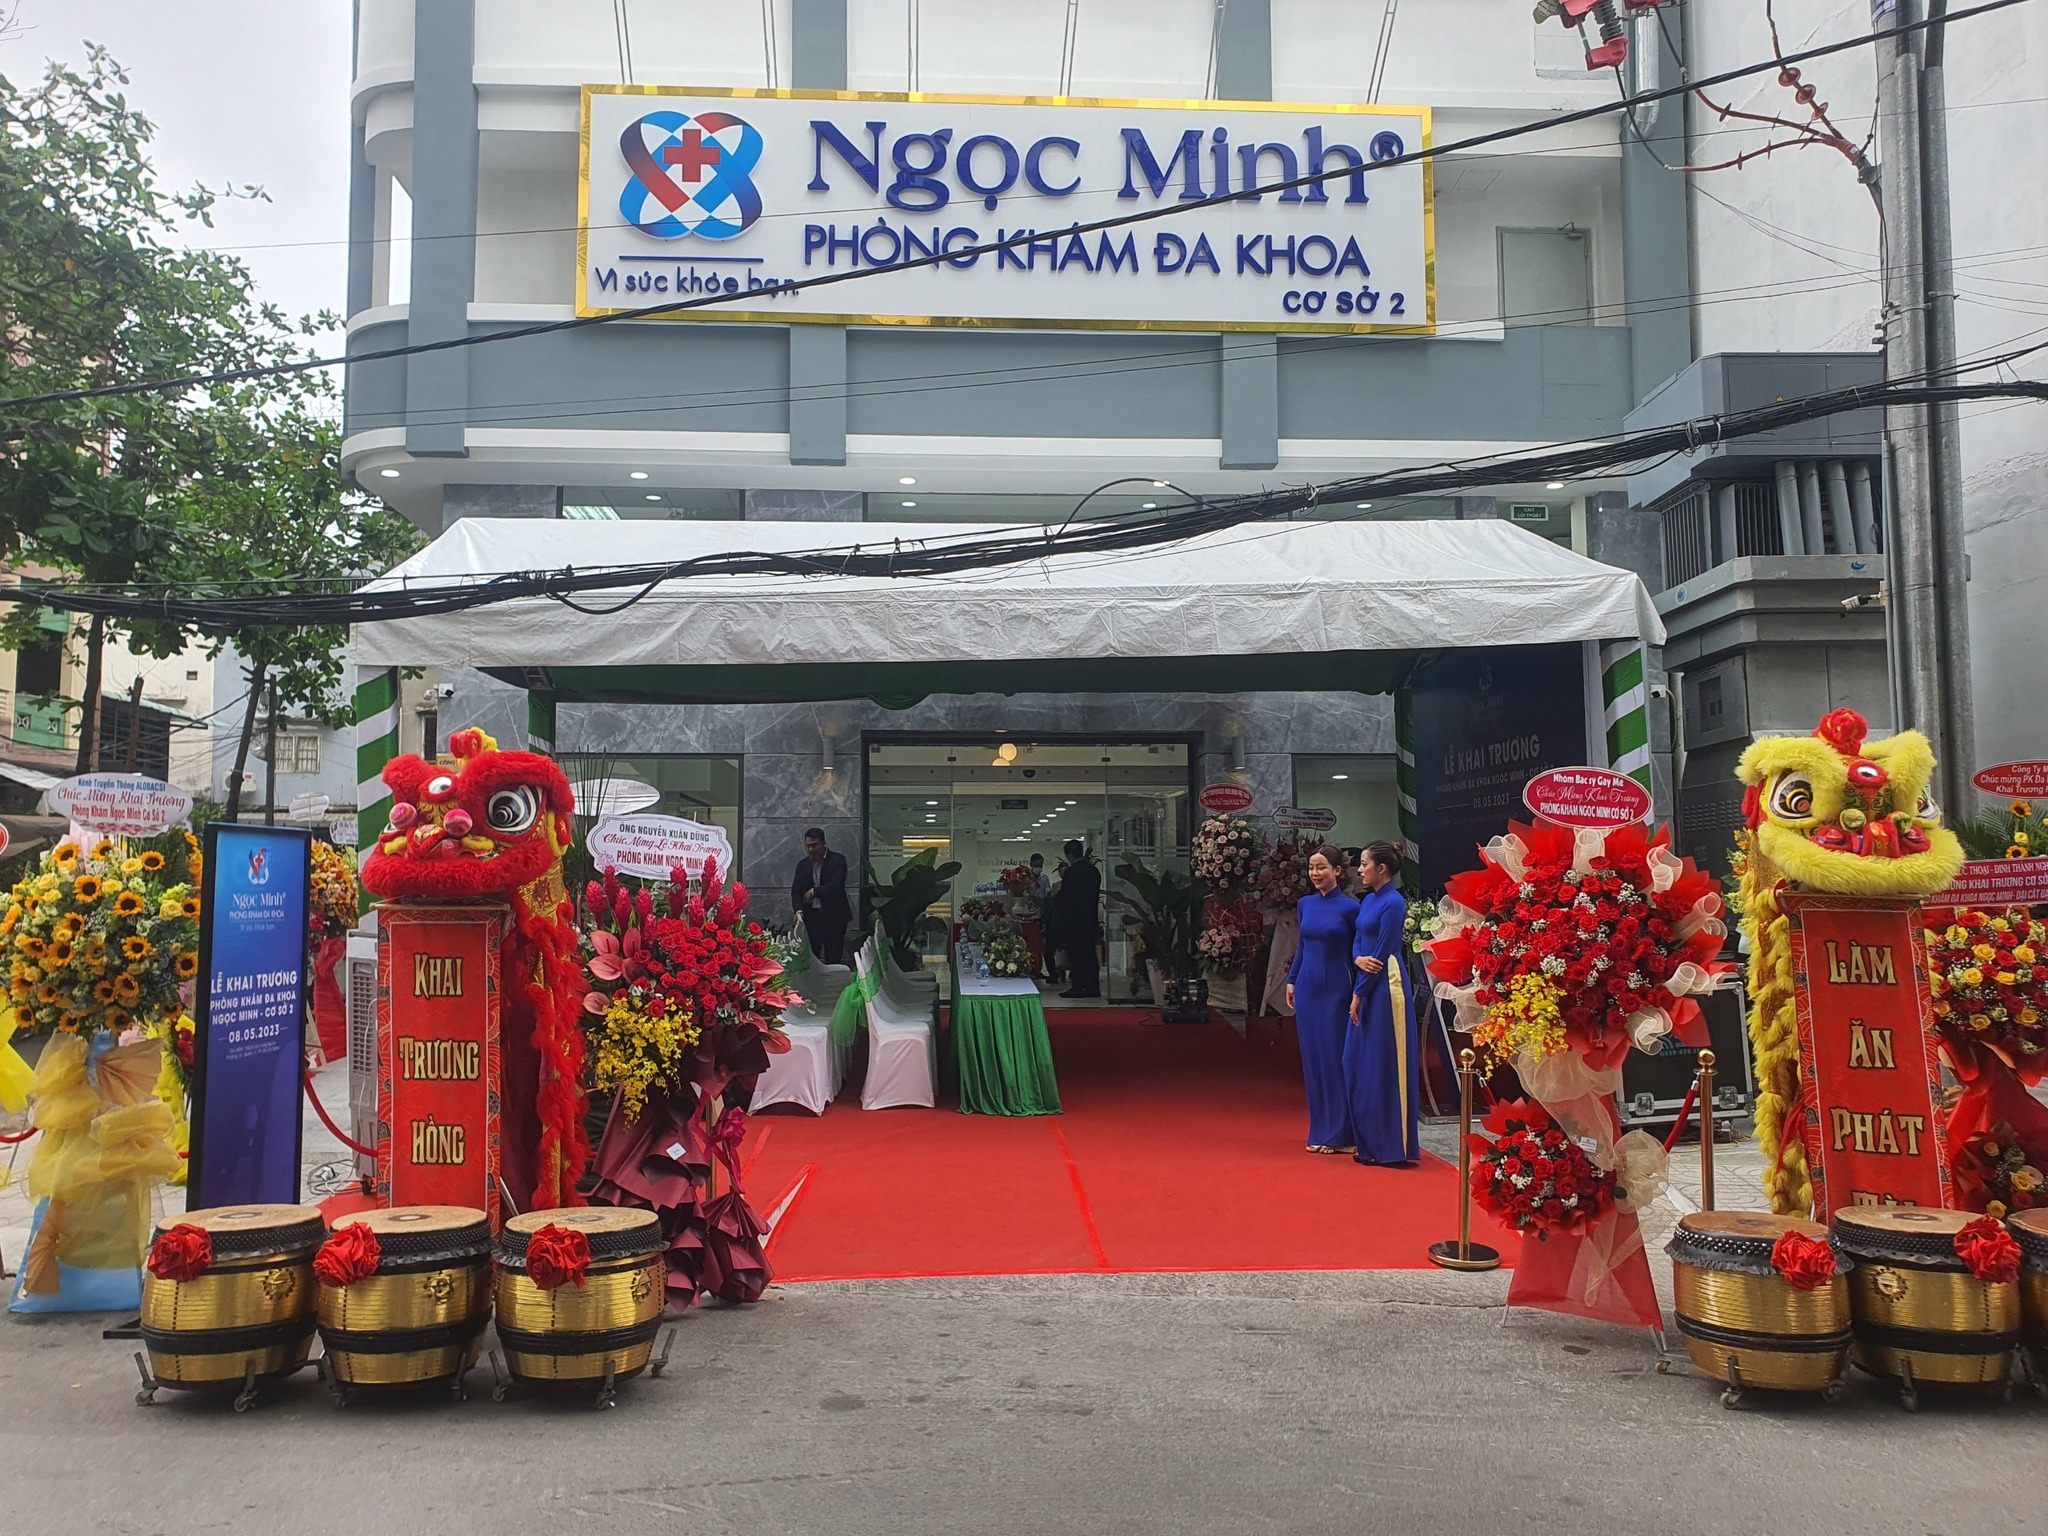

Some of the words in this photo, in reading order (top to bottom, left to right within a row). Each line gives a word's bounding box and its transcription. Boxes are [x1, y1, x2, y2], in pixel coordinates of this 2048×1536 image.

[807, 120, 1081, 212] Ngọc
[803, 216, 981, 270] PHÒNG
[998, 221, 1139, 274] KHÁM
[1153, 231, 1221, 276] ĐA
[1236, 233, 1371, 278] KHOA
[625, 271, 669, 293] sức
[1390, 292, 1405, 315] 2
[1458, 746, 1485, 773] KHAI
[1488, 734, 1540, 766] TRƯƠNG
[1980, 774, 1999, 783] Chúc
[2023, 775, 2034, 783] PK
[2035, 775, 2045, 783] Đa
[2011, 765, 2031, 775] Công
[2033, 765, 2041, 774] Ty
[57, 787, 82, 800] Chúc
[118, 791, 144, 805] Khai
[1996, 785, 2013, 793] Khai
[71, 804, 89, 819] Phòng
[91, 805, 108, 818] Khám
[110, 806, 125, 821] Ngọc
[127, 808, 141, 819] Minh
[161, 810, 165, 822] 2
[1540, 800, 1561, 813] PHÒNG
[1561, 801, 1579, 815] KHÁM
[1579, 805, 1596, 819] NGỌC
[1630, 809, 1635, 820] 2
[603, 833, 625, 845] Chúc
[669, 841, 692, 852] Khai
[619, 822, 636, 834] ÔNG
[637, 823, 667, 838] NGUYỄN
[669, 828, 688, 840] XUÂN
[690, 832, 709, 842] DŨNG
[617, 848, 642, 864] PHÒNG
[643, 851, 664, 866] KHÁM
[686, 858, 704, 871] MINH
[1969, 879, 1989, 889] KHAI
[1991, 876, 2024, 888] TRƯƠNG
[232, 893, 258, 909] Ngọc
[1824, 940, 1897, 986] LÀM
[211, 971, 223, 994] LỄ
[226, 975, 253, 992] KHAI
[256, 970, 297, 989] TRƯƠNG
[413, 953, 463, 999] KHAI
[210, 996, 239, 1011] PHÒNG
[240, 992, 262, 1007] KHÁM
[264, 993, 275, 1004] ĐA
[276, 990, 296, 1002] KHOA
[212, 1012, 236, 1026] NGỌC
[239, 1009, 259, 1022] MINH
[264, 1006, 276, 1018] CƠ
[277, 1002, 287, 1015] SỞ
[289, 1004, 294, 1014] 2
[228, 1024, 280, 1043] 08.05.2023
[1848, 1019, 1897, 1070] ĂN
[399, 1036, 480, 1081] TRƯƠNG
[411, 1114, 466, 1165] HỒNG
[1829, 1105, 1924, 1156] PHÁT
